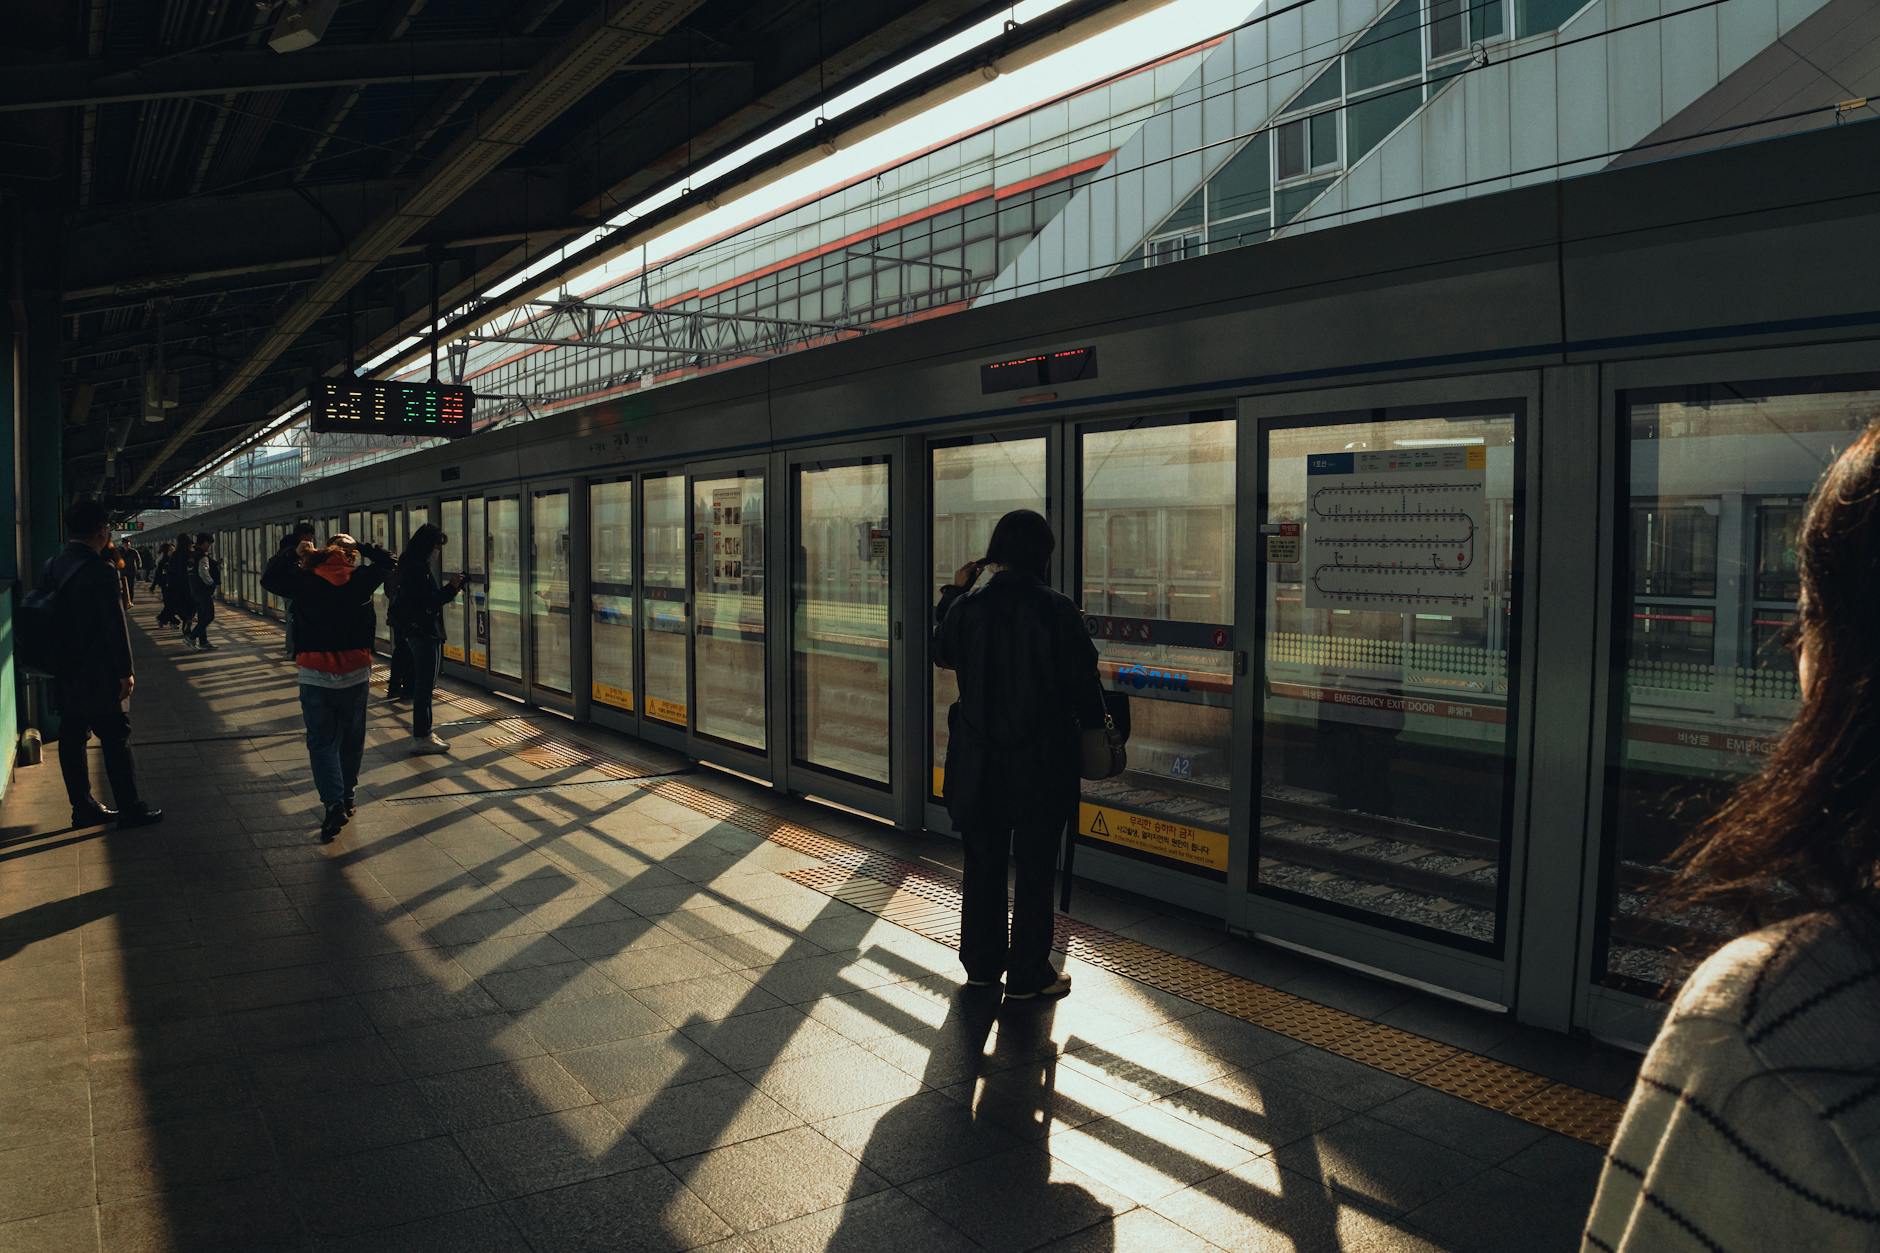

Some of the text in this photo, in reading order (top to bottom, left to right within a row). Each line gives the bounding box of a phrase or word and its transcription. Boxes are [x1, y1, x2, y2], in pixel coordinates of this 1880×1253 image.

[1118, 664, 1190, 691] KORAIL
[1334, 693, 1435, 713] EMERGENCY EXIT DOOR
[1678, 731, 1710, 746] 비상문
[1726, 738, 1778, 753] EMERGE
[1171, 757, 1190, 774] A2
[1129, 815, 1196, 841] 무리한 승하차 금지
